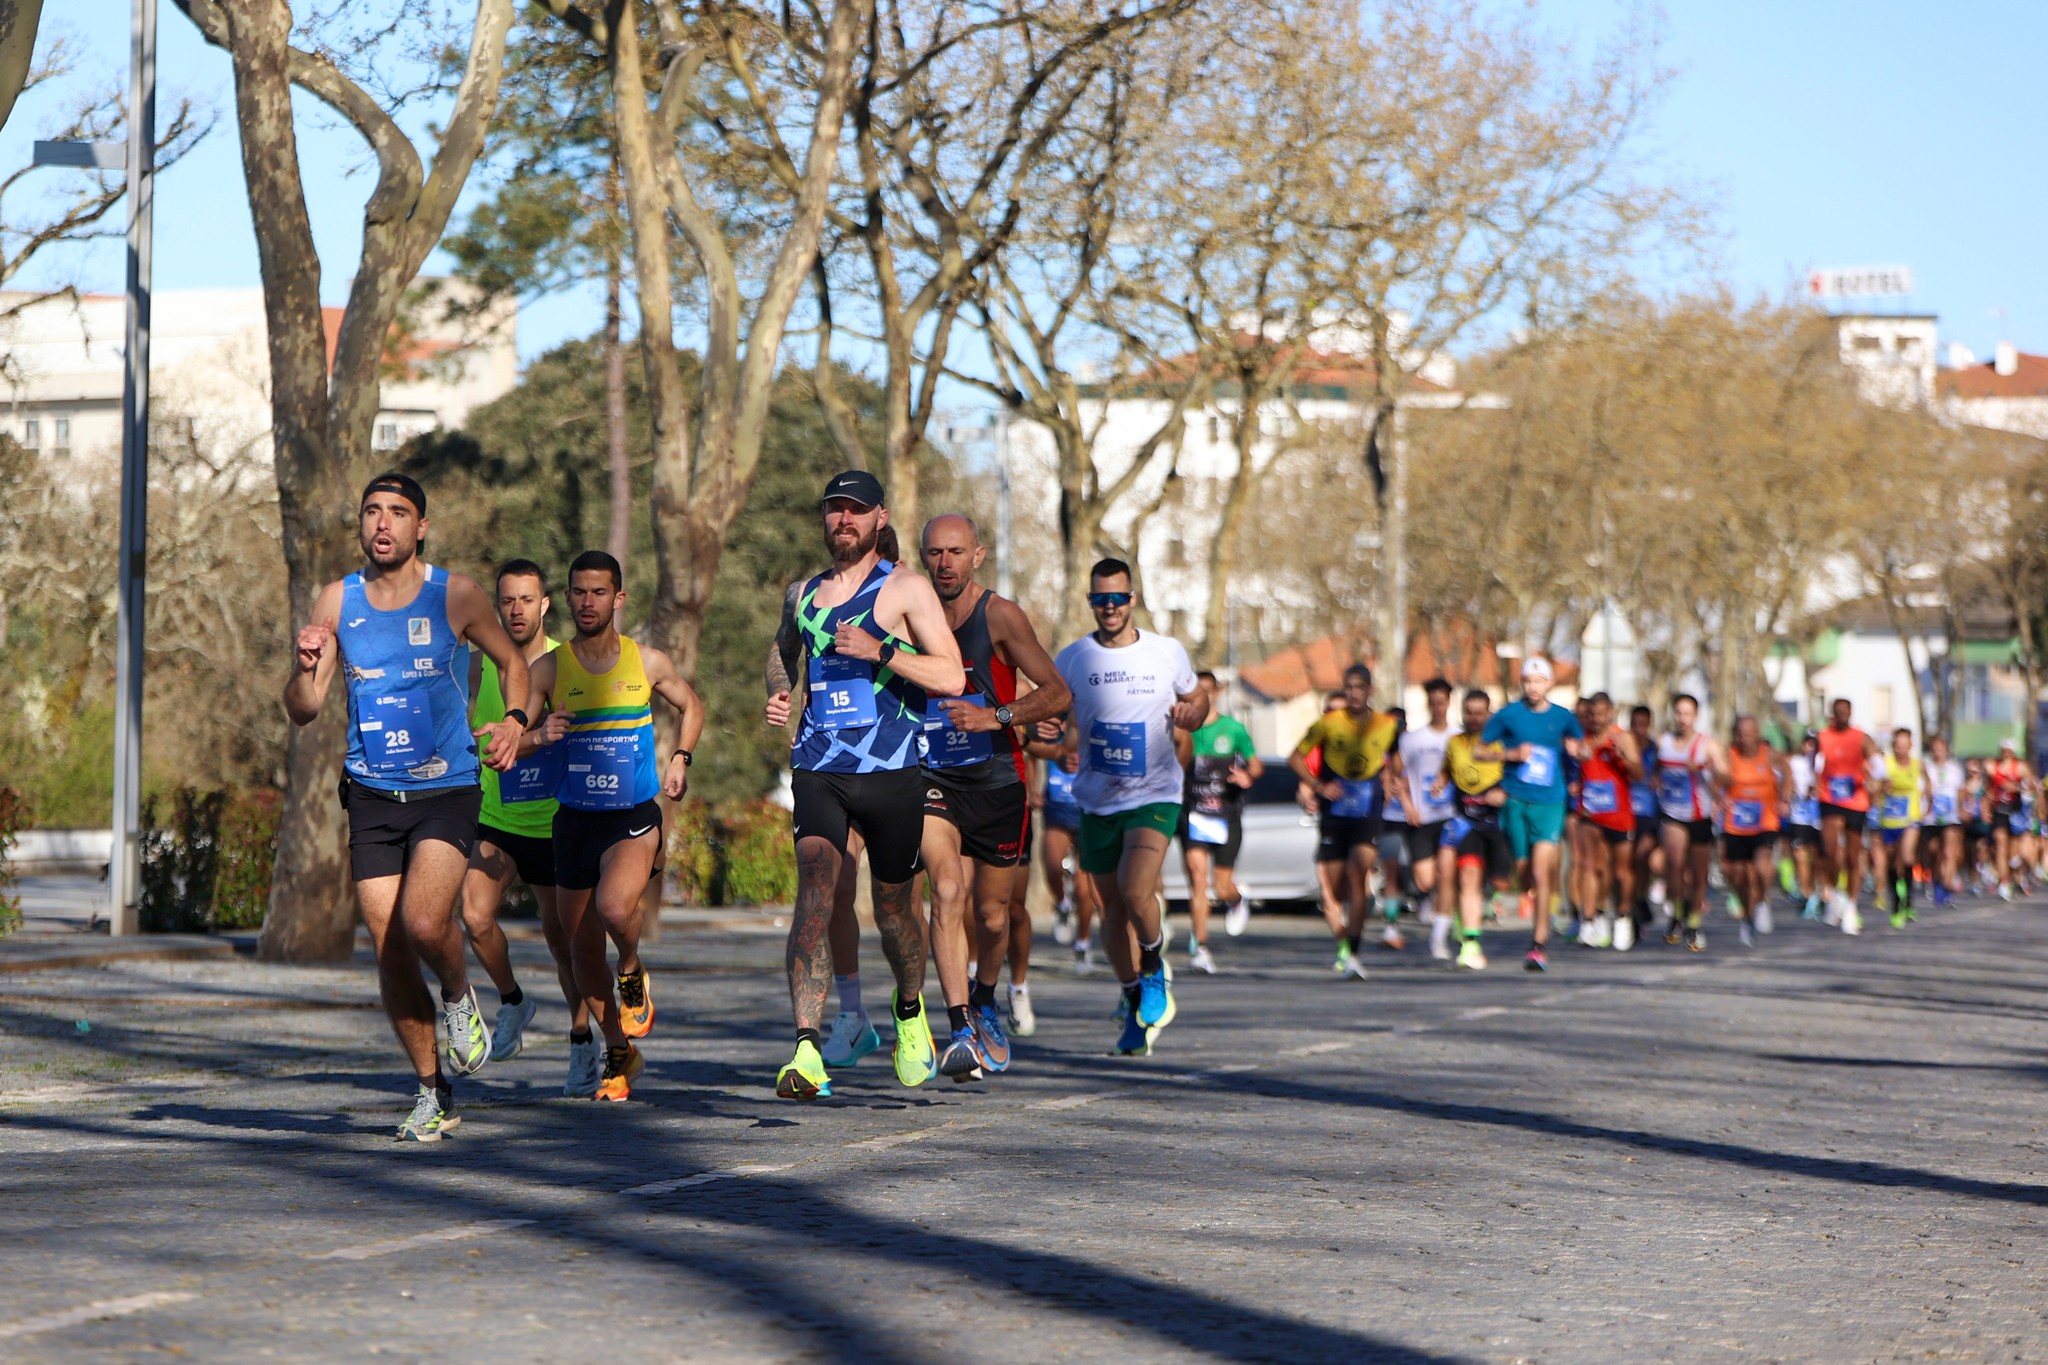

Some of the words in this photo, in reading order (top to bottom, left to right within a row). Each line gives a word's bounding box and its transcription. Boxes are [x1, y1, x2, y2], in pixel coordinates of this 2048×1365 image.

[1830, 270, 1906, 295] HOTEL
[1104, 671, 1126, 679] MEIA
[830, 691, 850, 707] 15
[385, 730, 410, 748] 28
[946, 731, 968, 746] 32
[1103, 748, 1132, 760] 645
[520, 768, 540, 782] 27
[586, 774, 618, 788] 662
